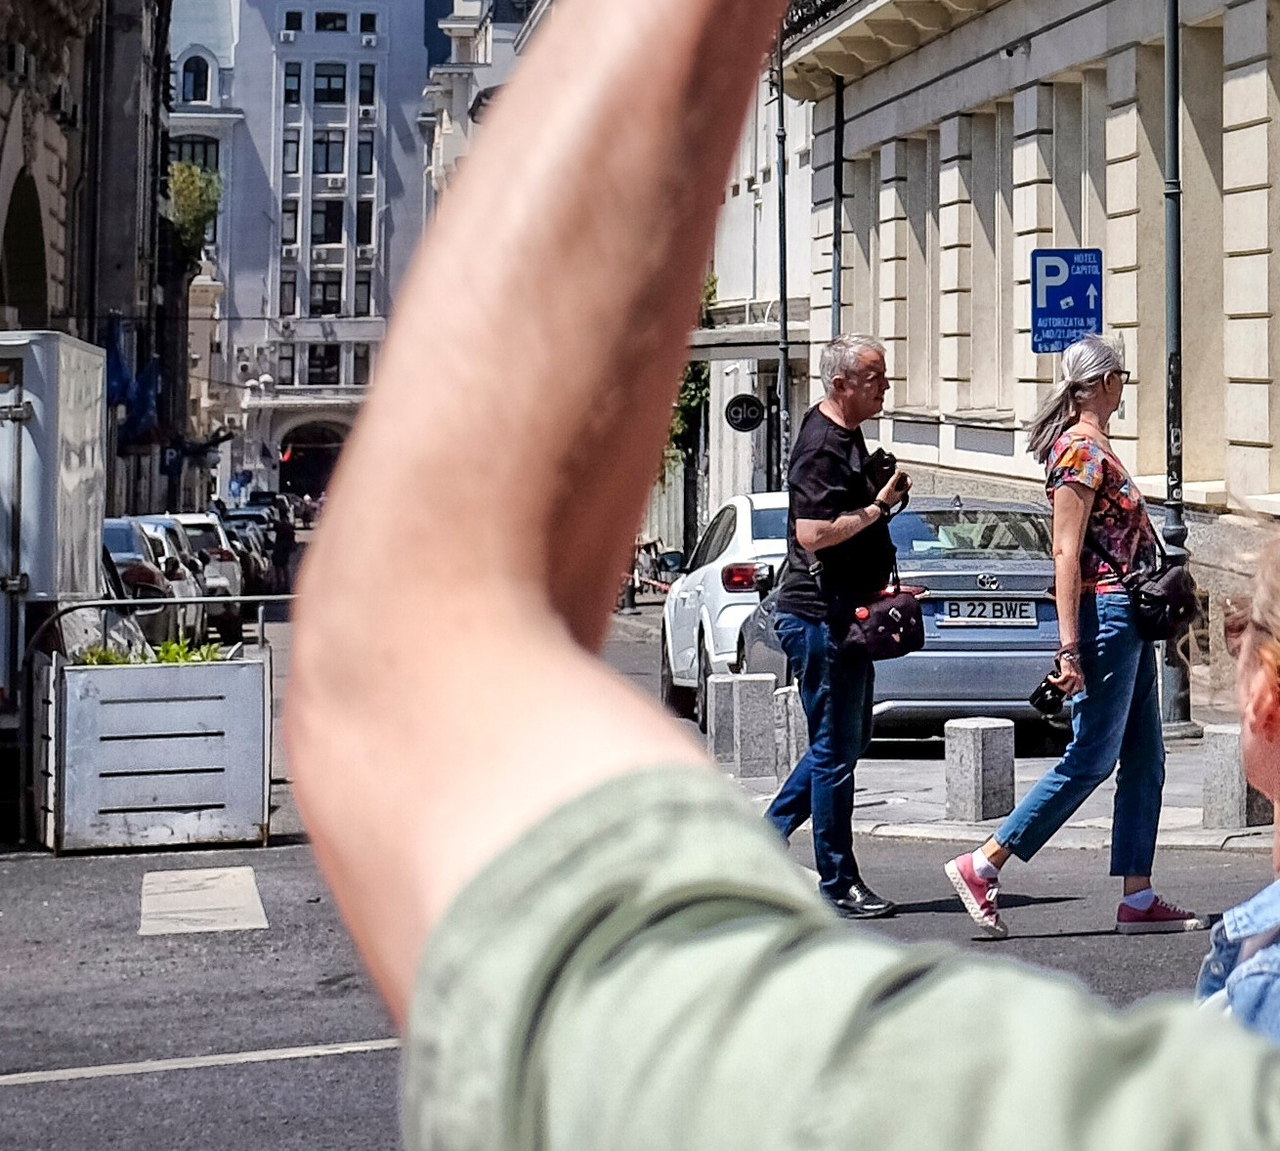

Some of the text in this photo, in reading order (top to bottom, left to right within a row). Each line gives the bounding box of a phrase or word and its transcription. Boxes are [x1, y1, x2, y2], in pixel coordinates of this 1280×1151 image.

[1073, 253, 1098, 263] HOTEL
[1071, 264, 1100, 275] CAPITOL
[1036, 256, 1069, 308] P
[730, 402, 760, 424] glo
[165, 448, 177, 466] P
[948, 602, 1031, 618] B 22 BWE
